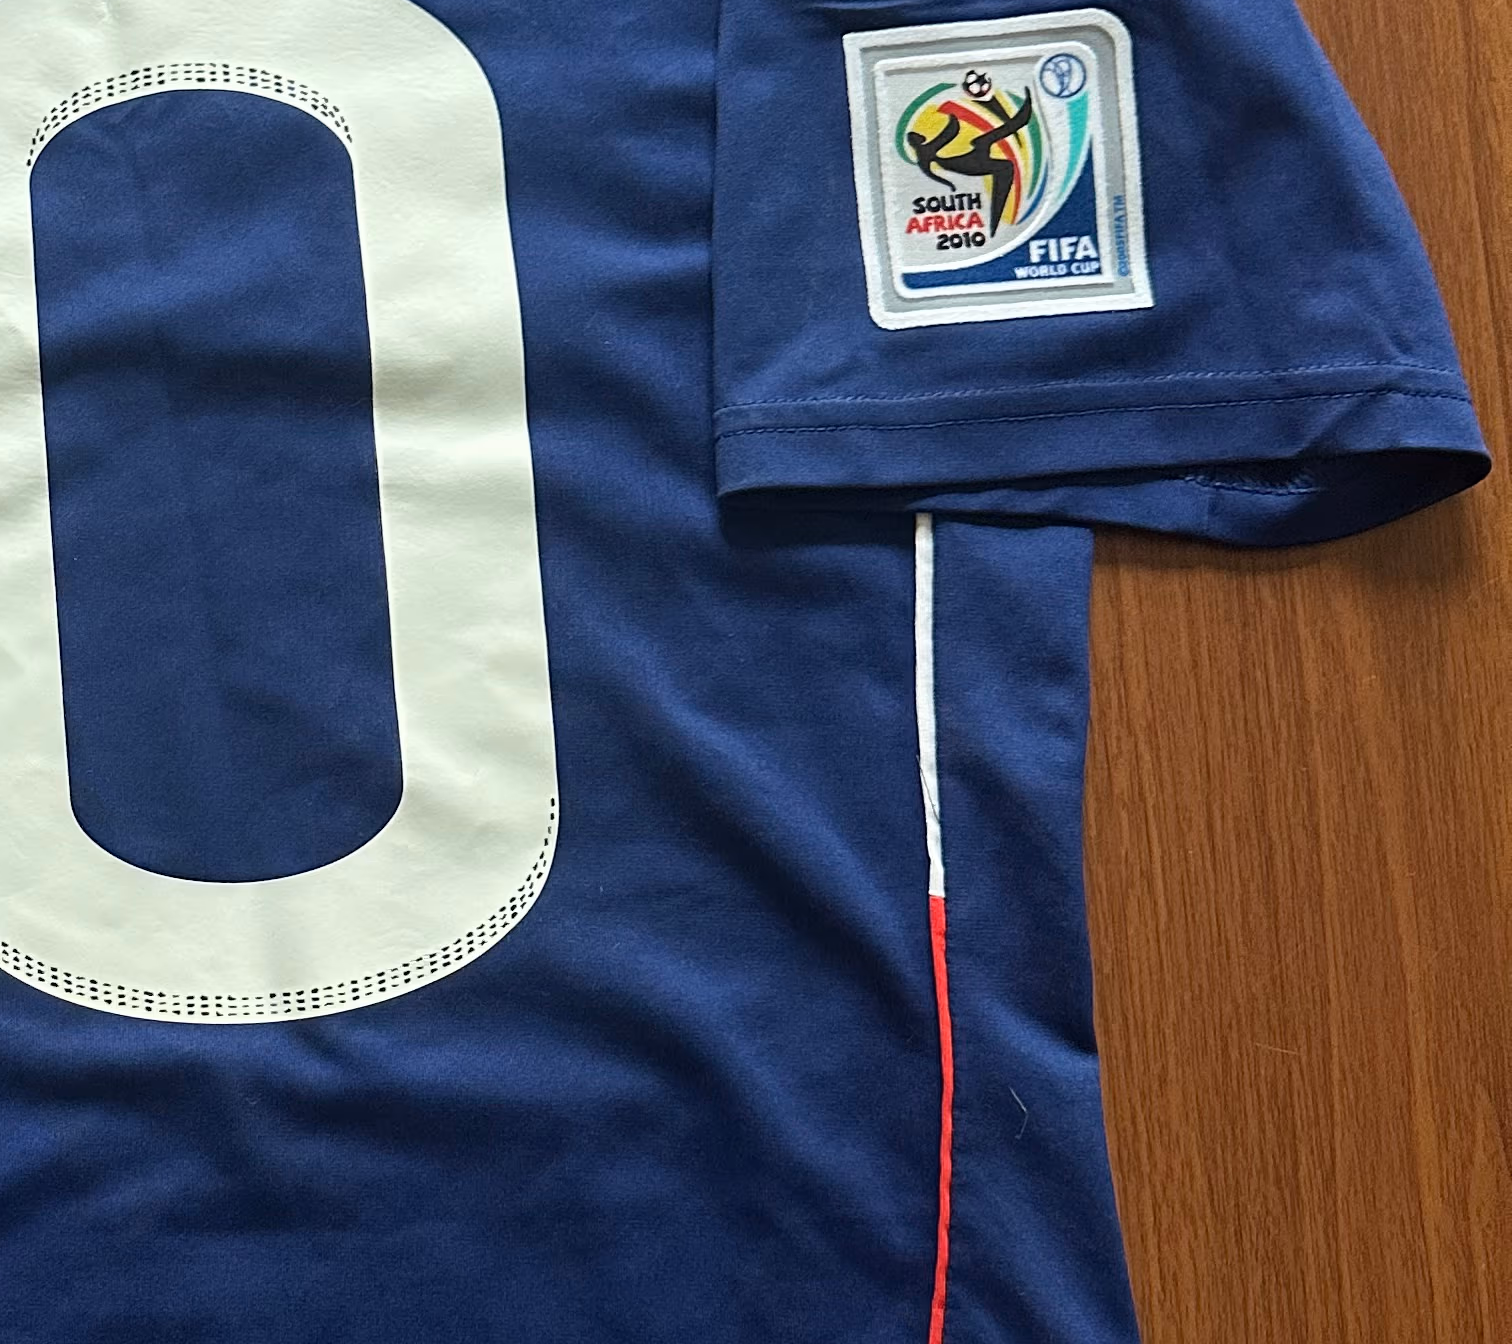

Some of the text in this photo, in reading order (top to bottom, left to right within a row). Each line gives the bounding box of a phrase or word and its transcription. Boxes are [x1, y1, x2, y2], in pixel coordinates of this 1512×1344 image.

[912, 192, 982, 214] SOUTH
[905, 212, 984, 234] AFRICA
[937, 232, 986, 250] 2010
[1028, 235, 1100, 264] FIFA
[1014, 262, 1101, 279] WORLD CUP
